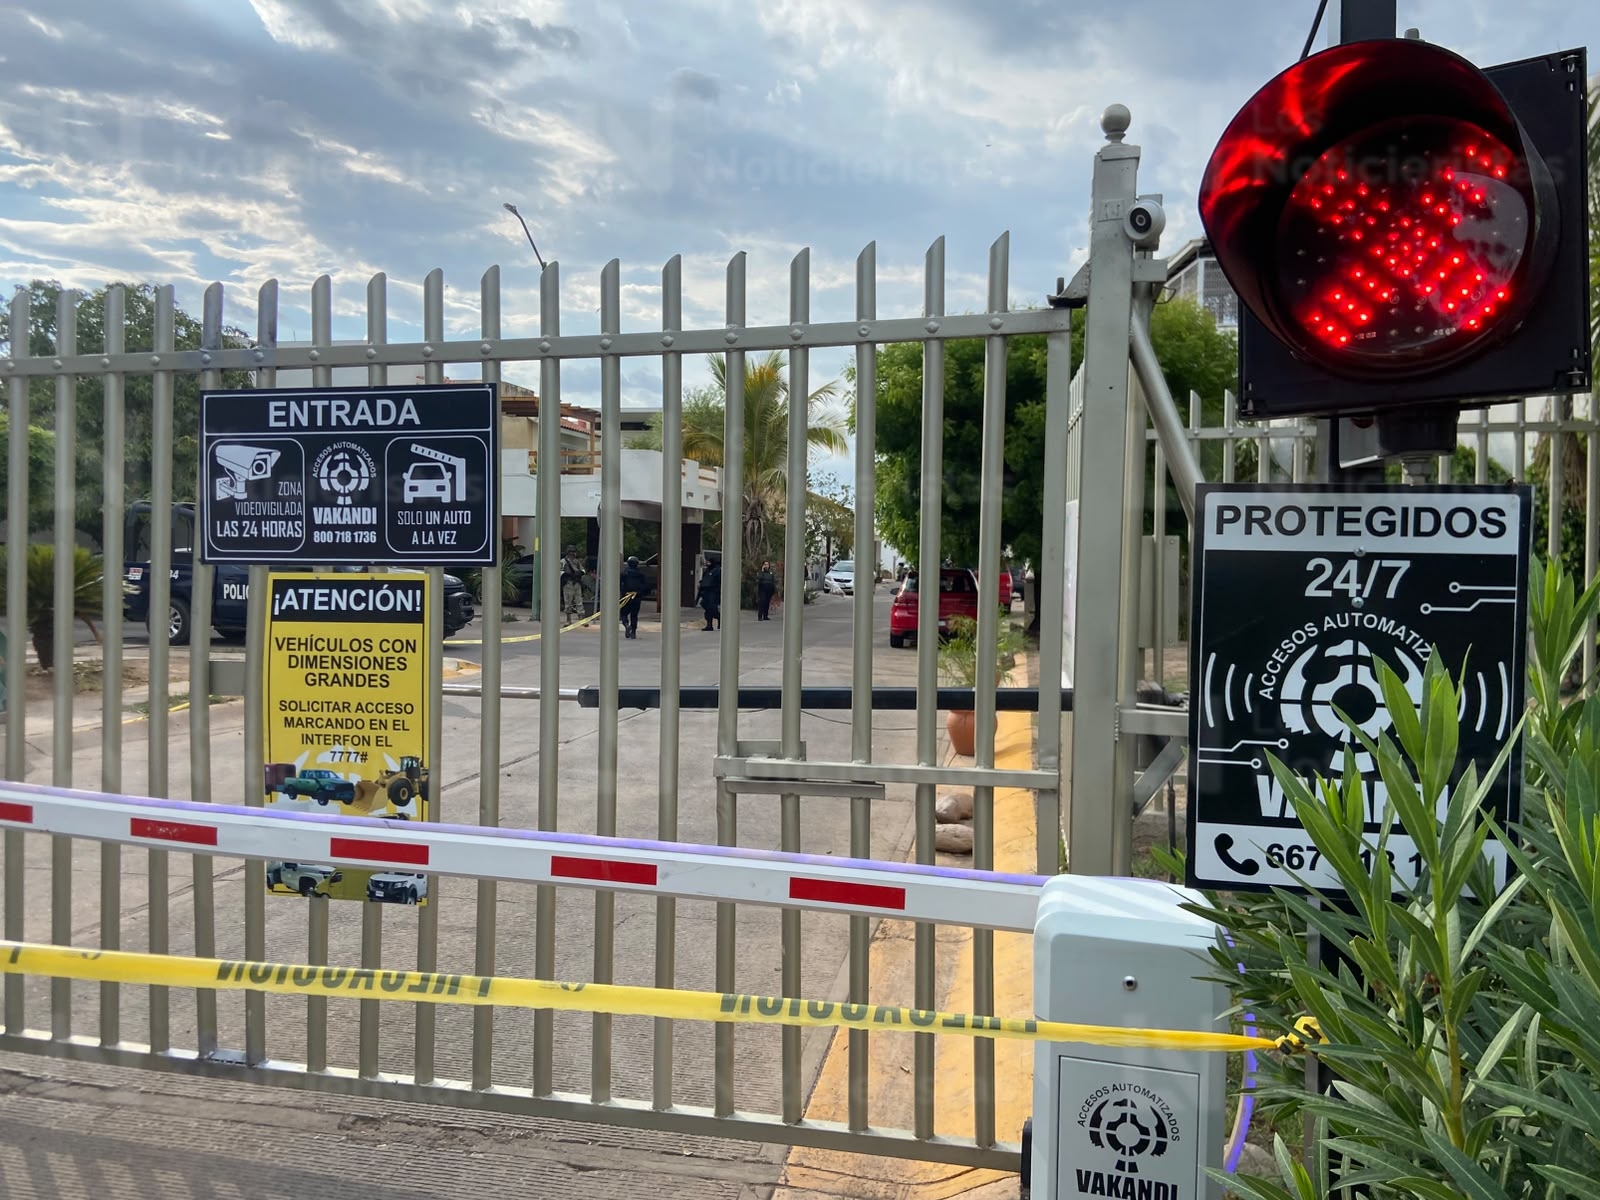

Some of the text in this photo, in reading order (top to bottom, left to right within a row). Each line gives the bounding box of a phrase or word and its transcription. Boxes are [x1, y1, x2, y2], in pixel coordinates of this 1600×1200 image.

[268, 398, 421, 427] ENTRADA
[312, 441, 377, 479] ACCESOS AUTOMATIZADOS
[278, 481, 303, 496] ZONA
[235, 501, 303, 516] VIDEOVIGILADA
[312, 507, 377, 525] VAKANDI
[397, 510, 471, 525] SOLO UN AUTO
[216, 520, 303, 538] LAS 24 HORAS
[1215, 505, 1507, 539] PROTEGIDOS
[313, 530, 377, 543] 800 718 1736
[412, 530, 457, 545] A LA VEZ
[1304, 557, 1411, 600] 24/7
[273, 584, 422, 616] ¡ATENCIÓN!
[275, 634, 417, 654] VEHÍCULOS CON
[288, 655, 408, 671] DIMENSIONES
[1259, 622, 1319, 700] ACCESOS
[304, 672, 390, 688] GRANDES
[279, 700, 415, 715] SOLICITAR ACCESO
[284, 716, 410, 731] MARCANDO EN EL
[301, 733, 393, 748] INTERFON EL
[330, 750, 369, 763] 7777#
[1265, 843, 1322, 872] 667
[1077, 1083, 1180, 1142] ACCESOS AUTOMATIZADOS
[1076, 1168, 1178, 1200] VAKANDI
